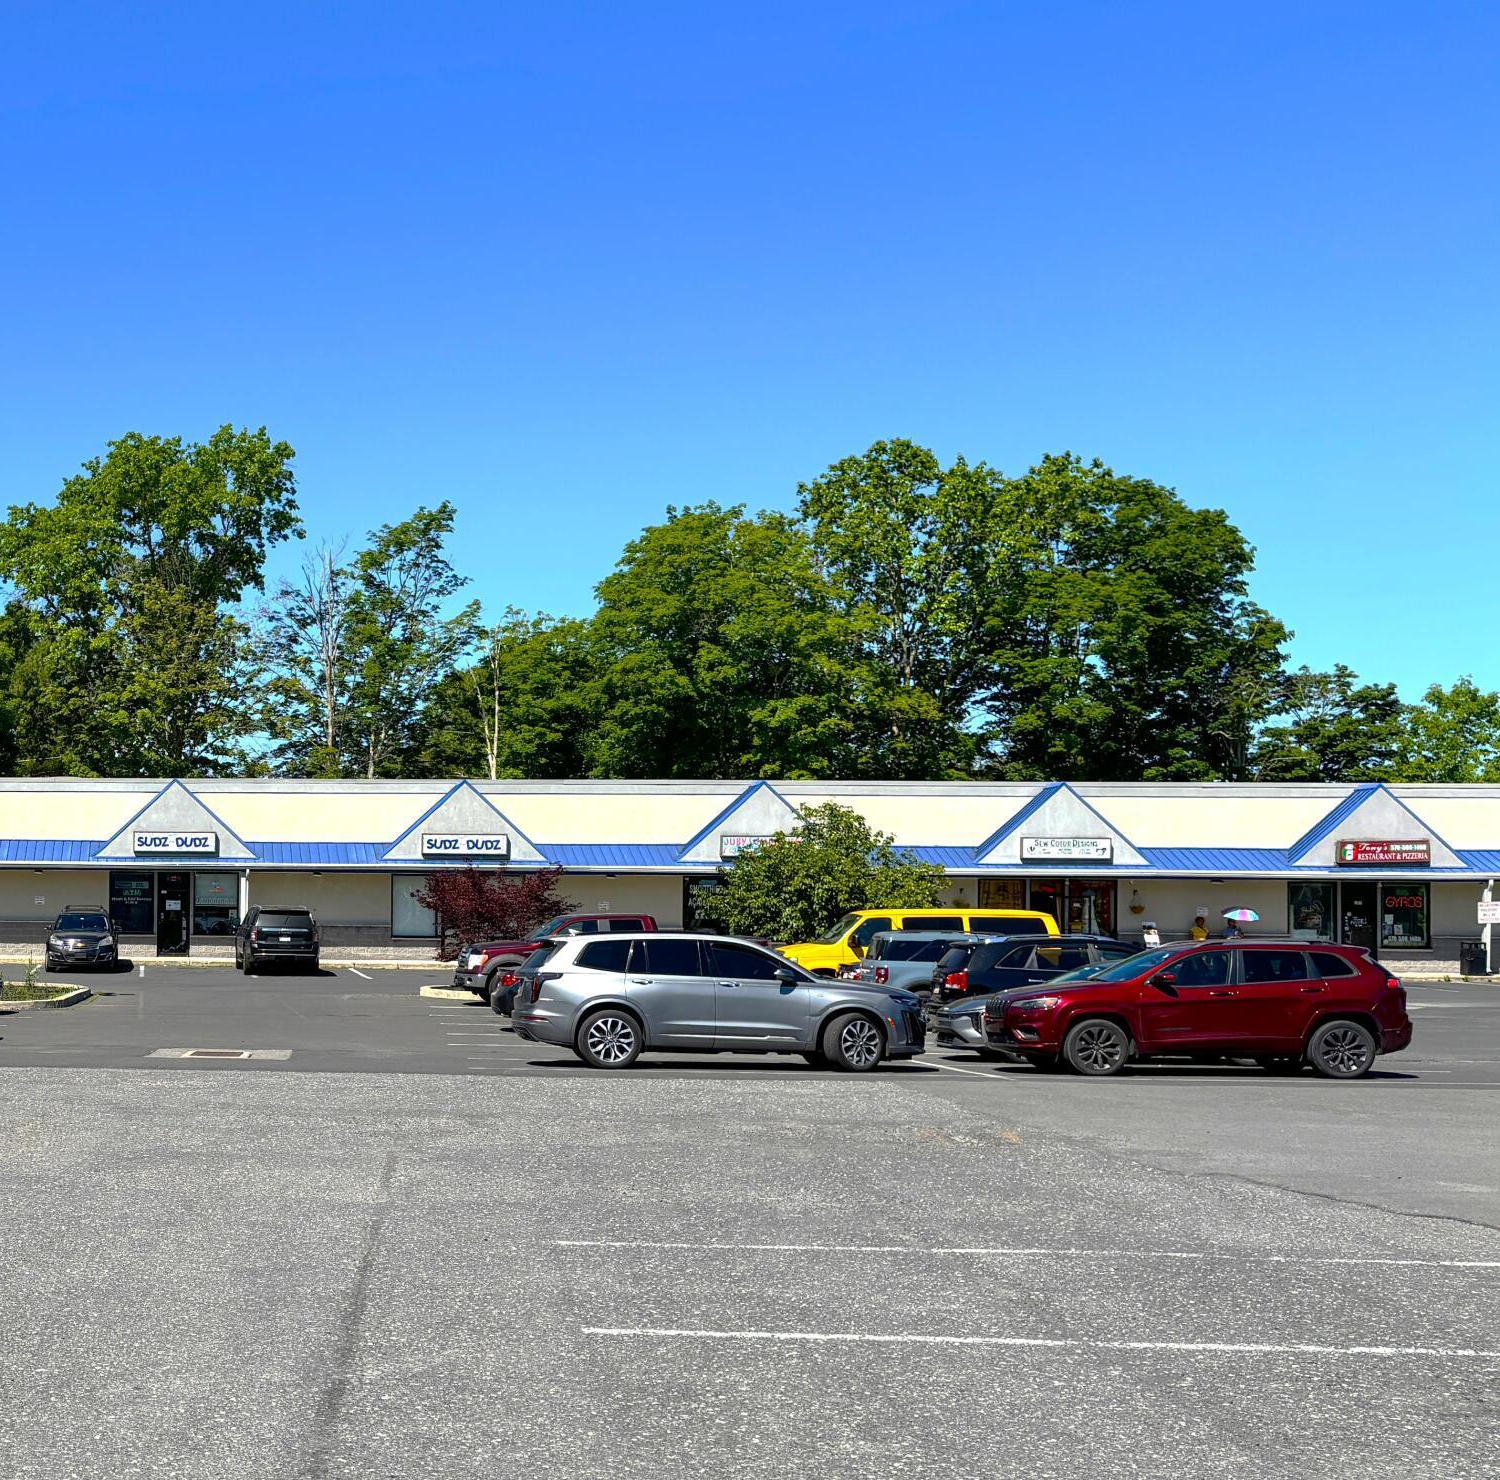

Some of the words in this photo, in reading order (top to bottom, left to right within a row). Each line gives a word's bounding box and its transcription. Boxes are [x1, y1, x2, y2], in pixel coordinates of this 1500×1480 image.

[137, 836, 169, 847] SUDZ
[175, 836, 209, 848] DUDZ
[426, 838, 460, 850] SUDZ
[466, 838, 501, 850] DUDZ
[1034, 839, 1049, 848] SEW
[1358, 842, 1388, 853] Tony's
[1357, 853, 1396, 861] RESTAURANT
[1385, 896, 1423, 908] GYROS
